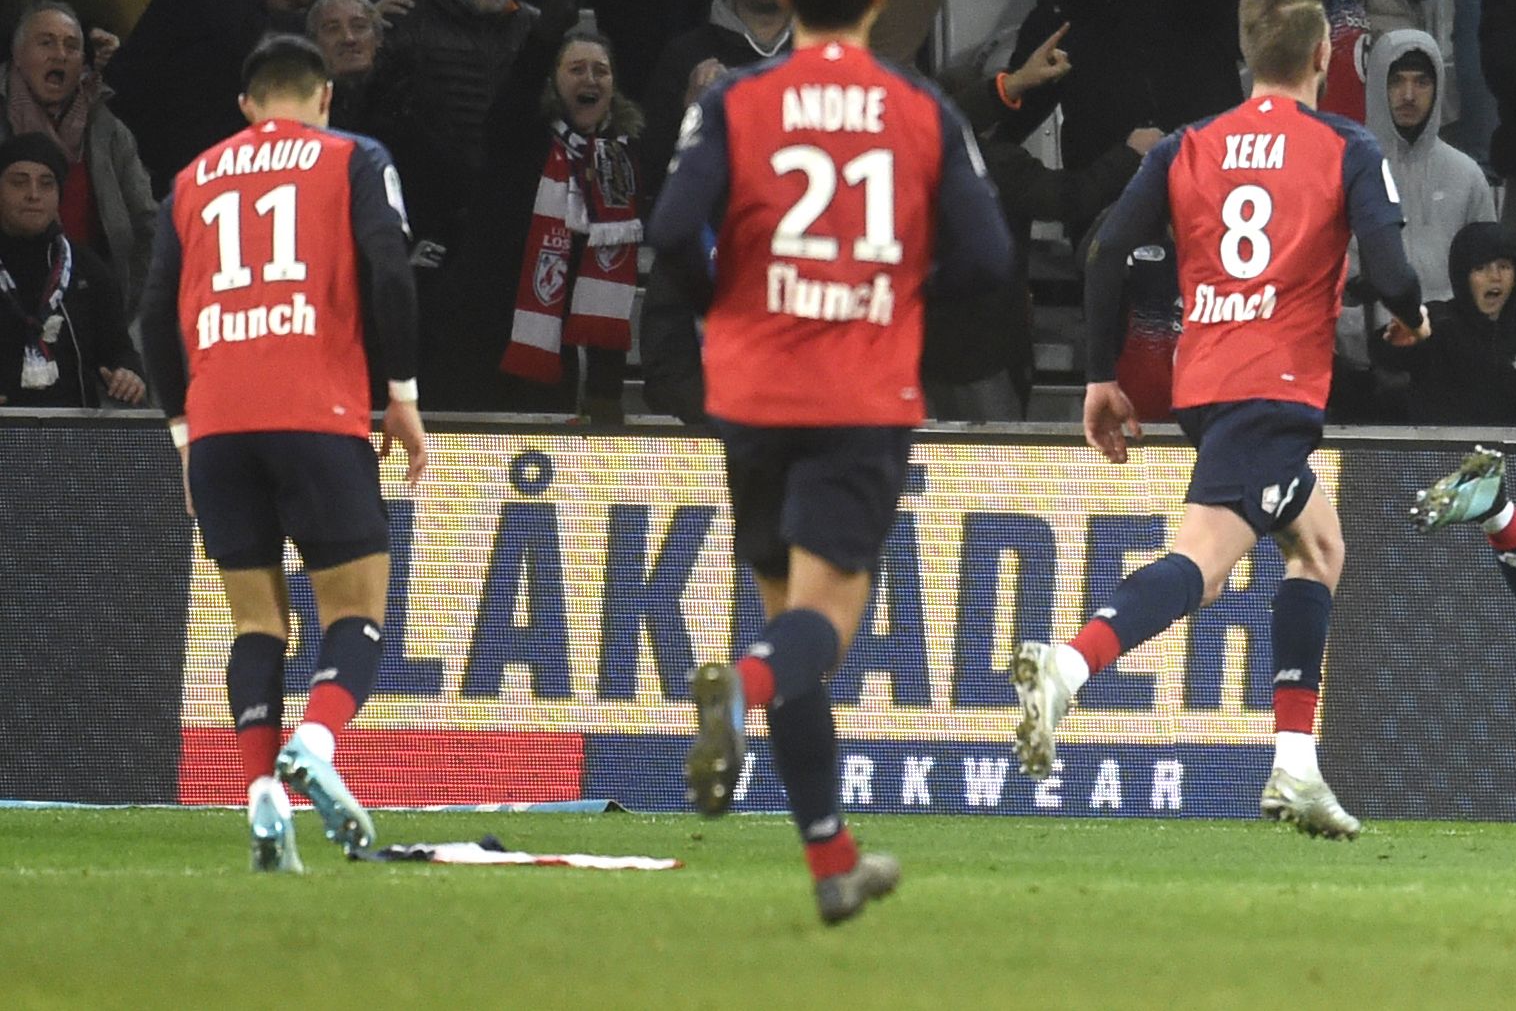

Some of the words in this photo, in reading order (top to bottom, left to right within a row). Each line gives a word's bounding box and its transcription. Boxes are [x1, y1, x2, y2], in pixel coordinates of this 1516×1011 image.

[781, 83, 887, 133] ANDRE
[195, 138, 321, 186] L.ARAUJO
[1221, 133, 1286, 170] XEKA
[770, 145, 904, 266] 21
[1219, 183, 1273, 280] 8
[200, 182, 308, 293] 11
[542, 234, 571, 250] LOS
[195, 292, 316, 351] flunch
[767, 261, 895, 326] flunch
[733, 752, 1184, 810] RKWEAR
